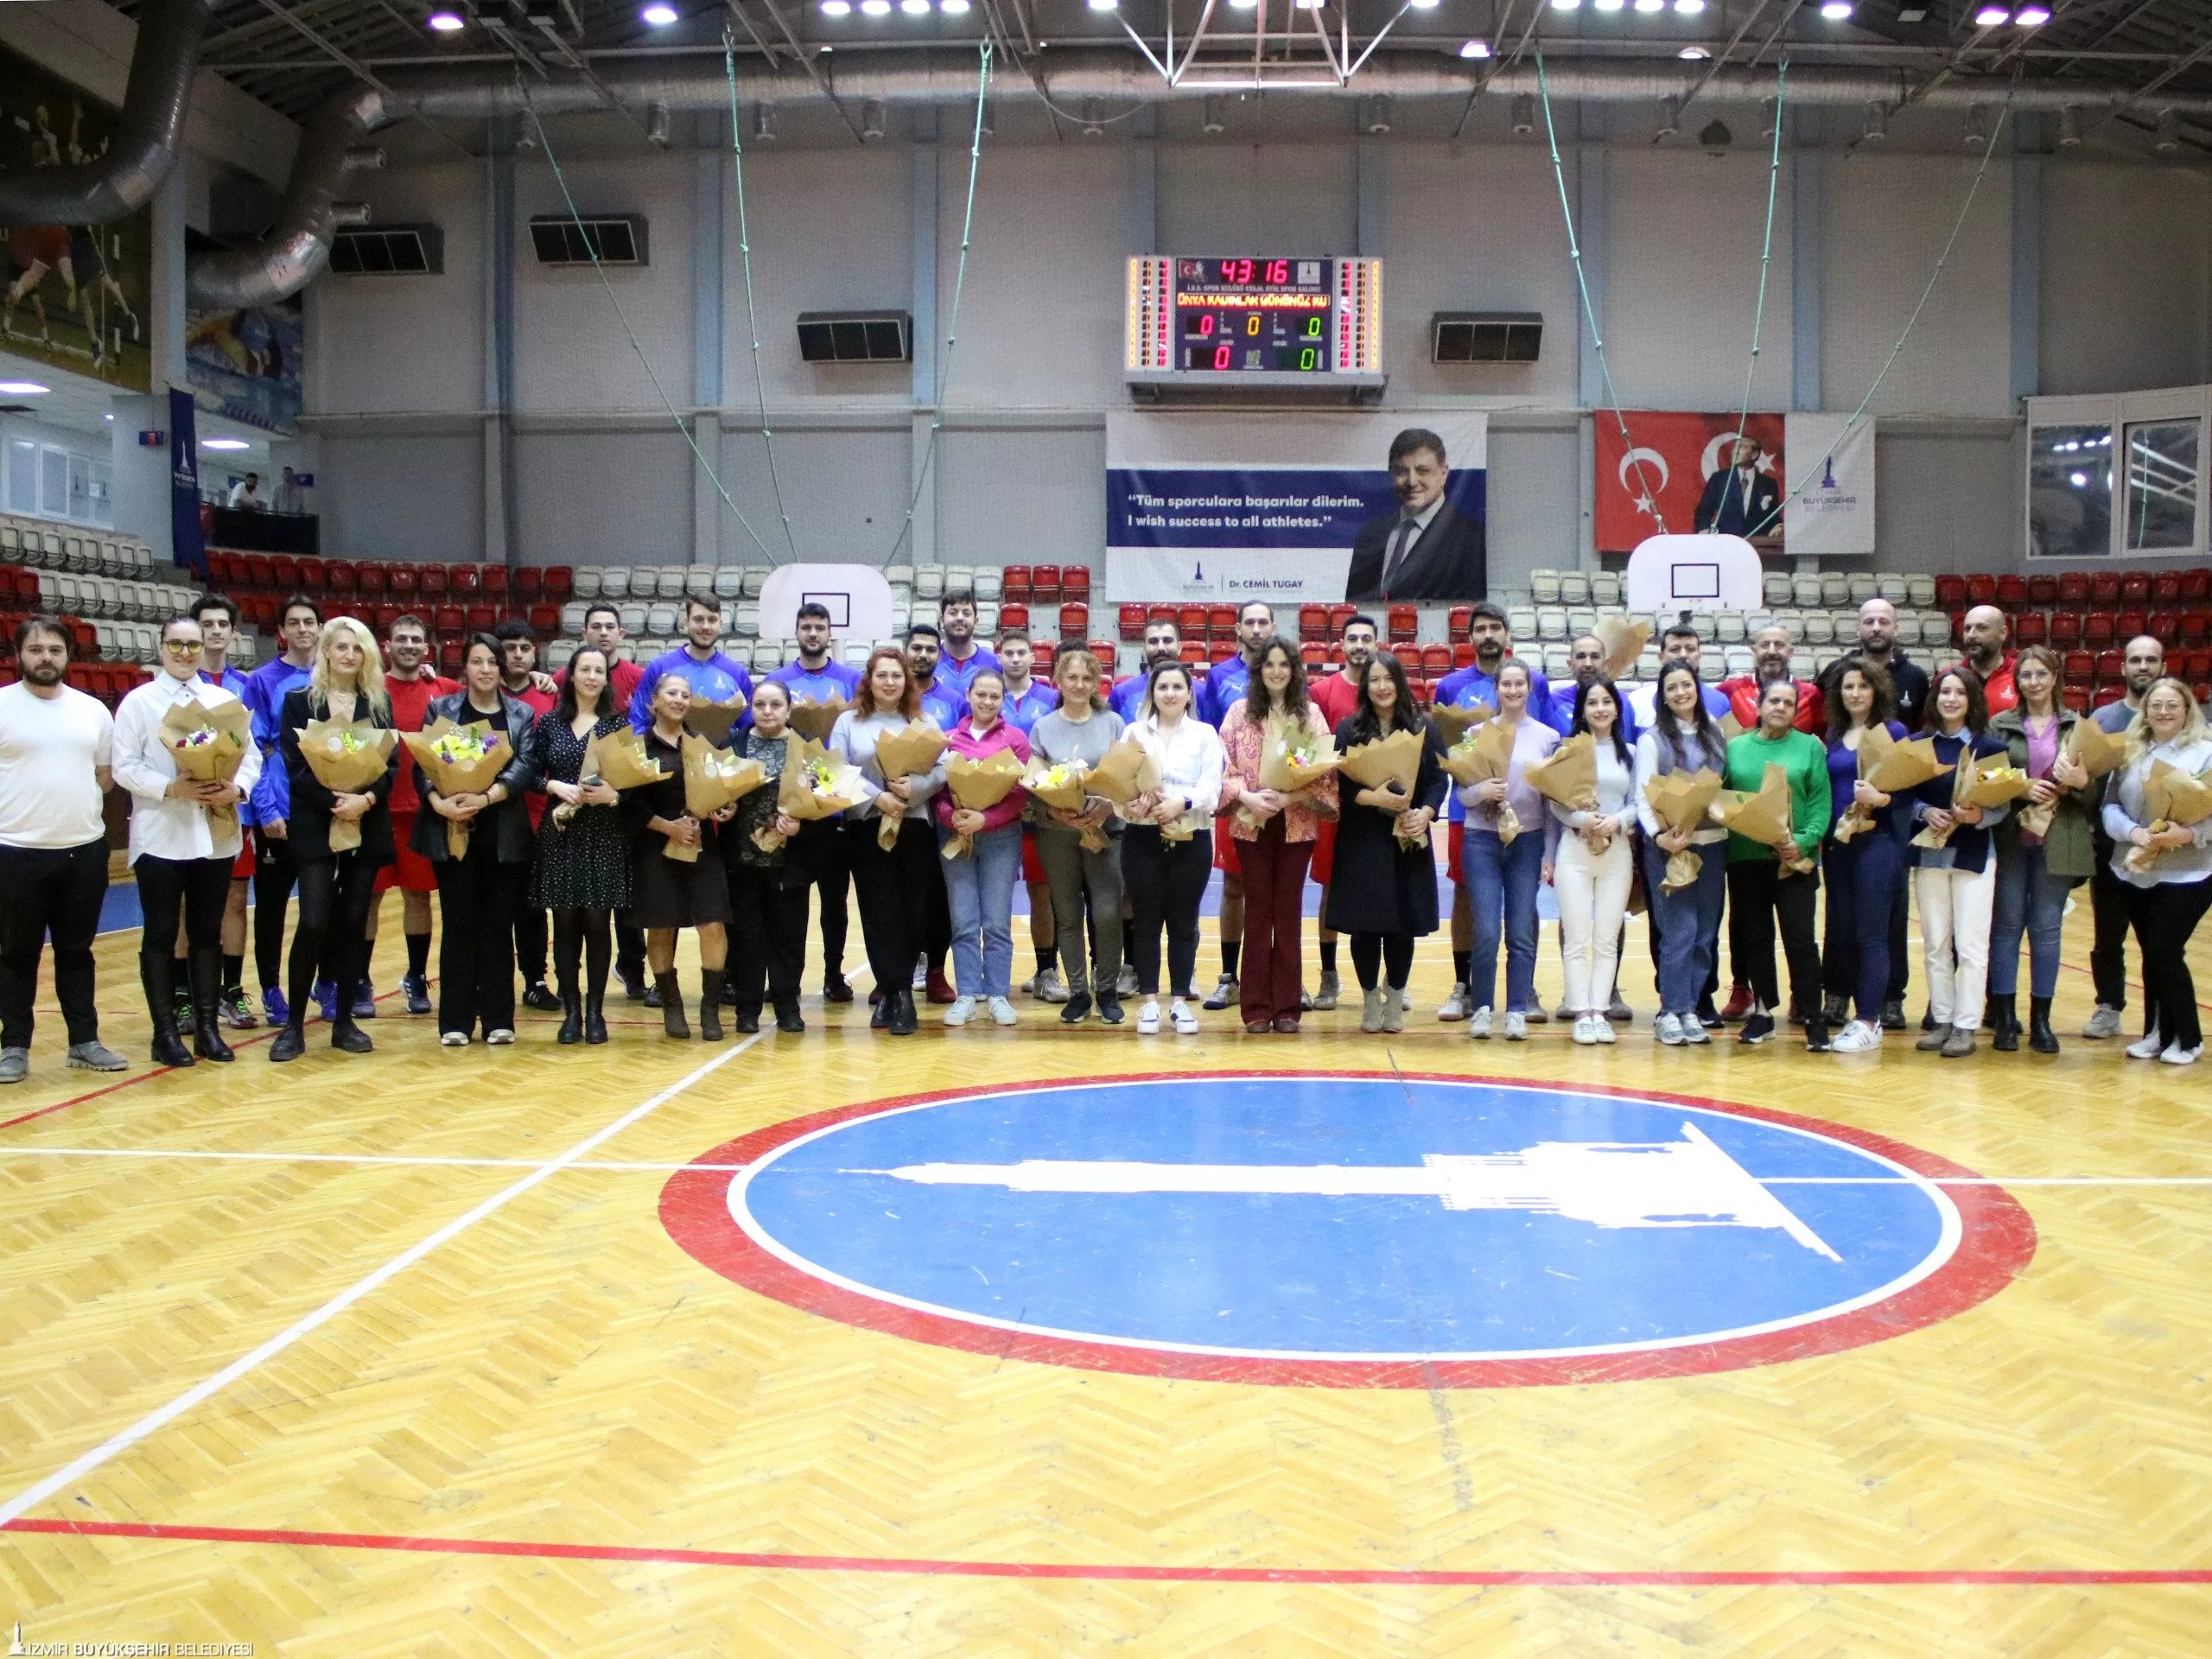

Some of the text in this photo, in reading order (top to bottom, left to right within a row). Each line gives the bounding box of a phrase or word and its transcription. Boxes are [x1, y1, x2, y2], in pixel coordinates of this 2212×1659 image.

[1199, 315, 1213, 335] 0
[1247, 315, 1260, 336] 0
[1308, 316, 1320, 336] 0
[1214, 346, 1230, 370] 0
[1300, 348, 1314, 370] 0
[1167, 495, 1243, 509] sporculara
[1245, 495, 1309, 509] başarılar
[1312, 495, 1364, 507] dilerim.
[1128, 514, 1132, 526] I
[1135, 514, 1166, 526] wish
[1168, 517, 1222, 527] success
[1224, 516, 1239, 527] to
[1242, 515, 1259, 527] all
[1229, 578, 1304, 588] Dr. CEMİL TUGAY
